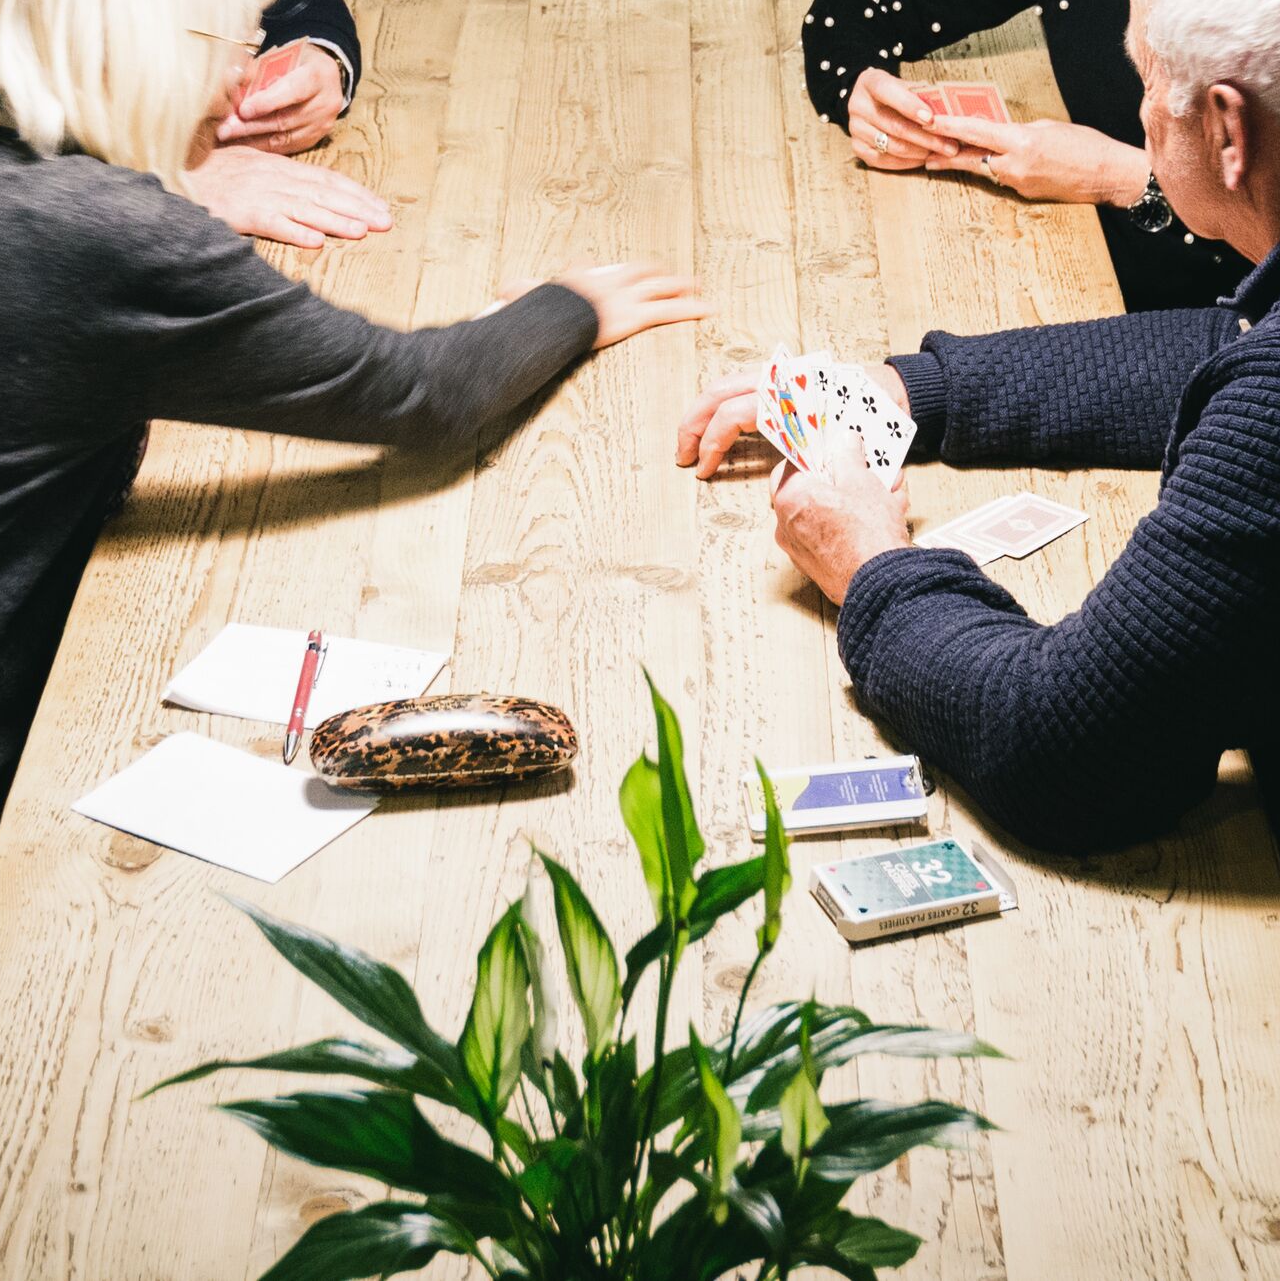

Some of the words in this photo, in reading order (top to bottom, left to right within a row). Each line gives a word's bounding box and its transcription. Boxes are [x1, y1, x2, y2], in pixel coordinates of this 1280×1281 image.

[911, 858, 953, 887] 32
[927, 906, 959, 920] CARTES
[962, 901, 979, 916] 32
[878, 913, 925, 931] PLASTIFIEES
